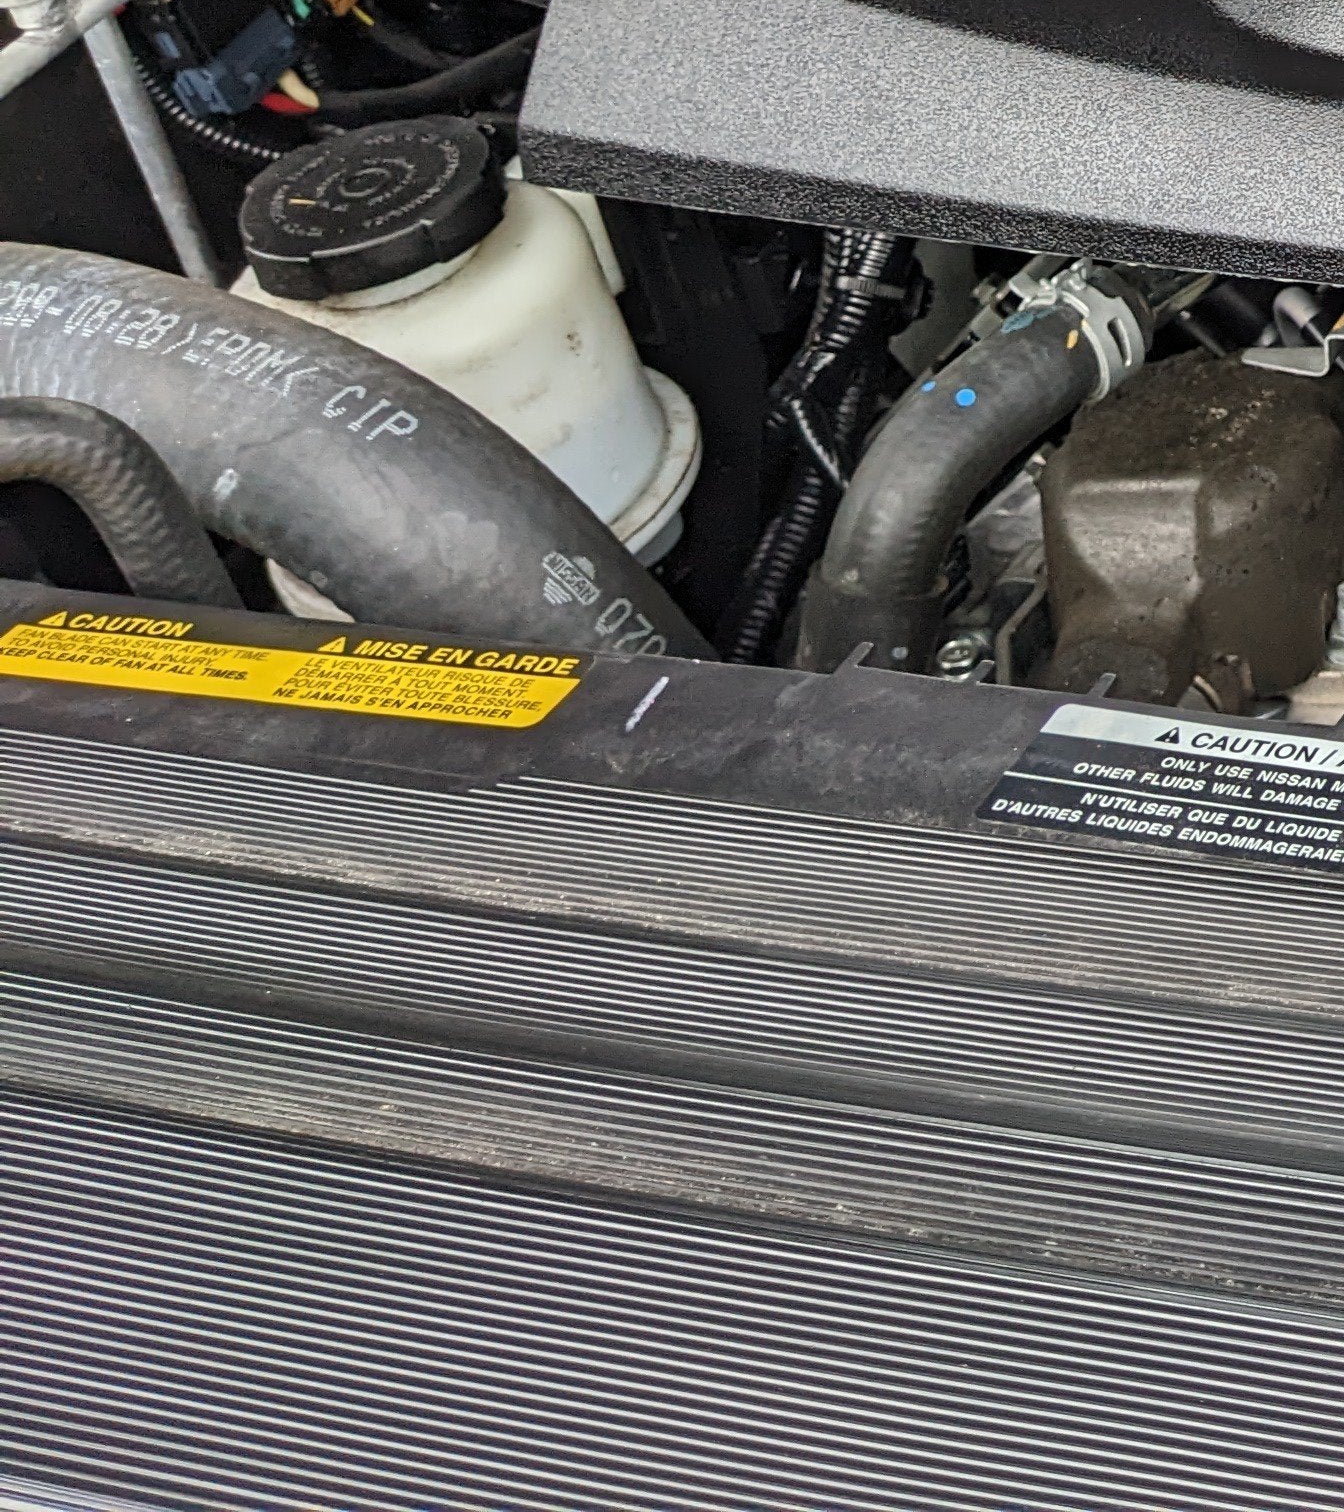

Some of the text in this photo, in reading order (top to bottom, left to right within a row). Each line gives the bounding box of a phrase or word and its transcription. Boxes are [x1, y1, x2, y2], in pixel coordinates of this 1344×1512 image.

[69, 613, 194, 637] CAUTION
[9, 638, 31, 647] TO
[30, 640, 77, 651] AVOID
[77, 644, 156, 661] PERSONAL
[18, 629, 49, 639] FAN
[50, 632, 99, 643] BLADE
[99, 636, 134, 647] CAN
[131, 639, 181, 651] START
[181, 645, 200, 654] AT
[353, 639, 581, 675] MISE EN GARDE
[37, 651, 90, 663] CLEAR
[89, 656, 114, 665] OF
[113, 659, 147, 670] FAN
[146, 663, 168, 672] AT
[167, 665, 196, 676] ALL
[305, 658, 536, 688] LE VENTILATEUR RISQUE DE
[283, 677, 331, 689] POUR
[397, 688, 450, 701] TOUTE
[406, 678, 450, 690] TOUT
[272, 687, 513, 720] NE JAMAIS S'EN APPROCHER
[1190, 732, 1320, 764] CAUTION
[1072, 762, 1137, 781] OTHER
[1139, 772, 1208, 792] FLUIDS
[1211, 782, 1255, 799] WILL
[1259, 790, 1342, 811] DAMAGE
[1160, 756, 1212, 774] ONLY
[1214, 764, 1254, 779] USE
[1256, 770, 1327, 790] NISSAN
[990, 798, 1084, 823] D'AUTRES
[1085, 812, 1174, 838] LIQUIDES
[1079, 792, 1184, 819] N'UTILISER
[1187, 809, 1230, 827] QUE
[1232, 815, 1263, 831] DU
[1264, 819, 1343, 843] LIQUIDE
